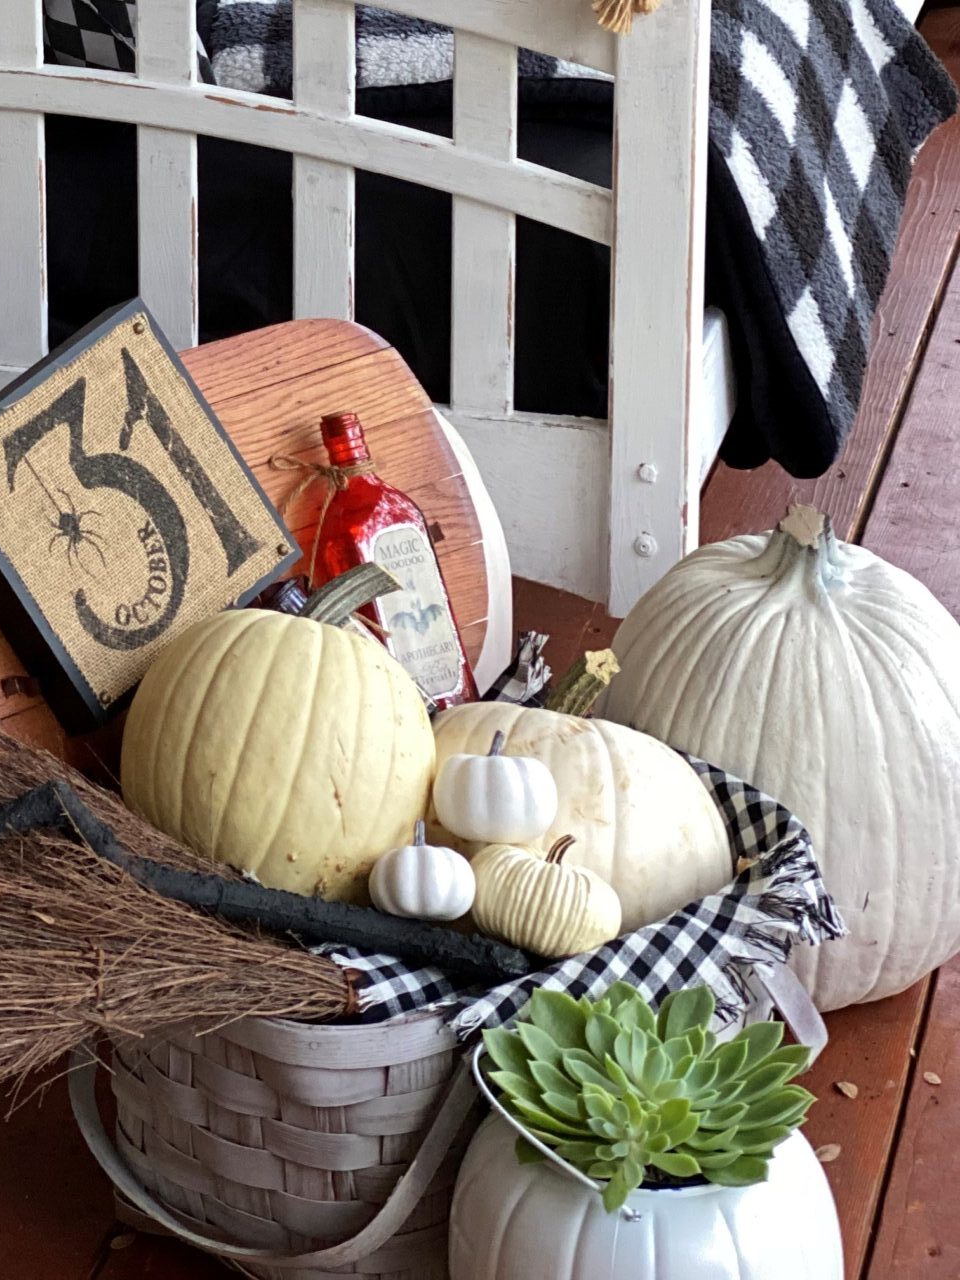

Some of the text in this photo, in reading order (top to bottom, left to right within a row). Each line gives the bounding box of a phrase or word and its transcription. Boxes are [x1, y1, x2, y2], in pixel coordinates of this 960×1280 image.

[2, 346, 267, 652] 31
[114, 519, 175, 627] OCTOBER
[379, 538, 421, 561] MAGIC
[401, 640, 455, 664] APOTHECARY
